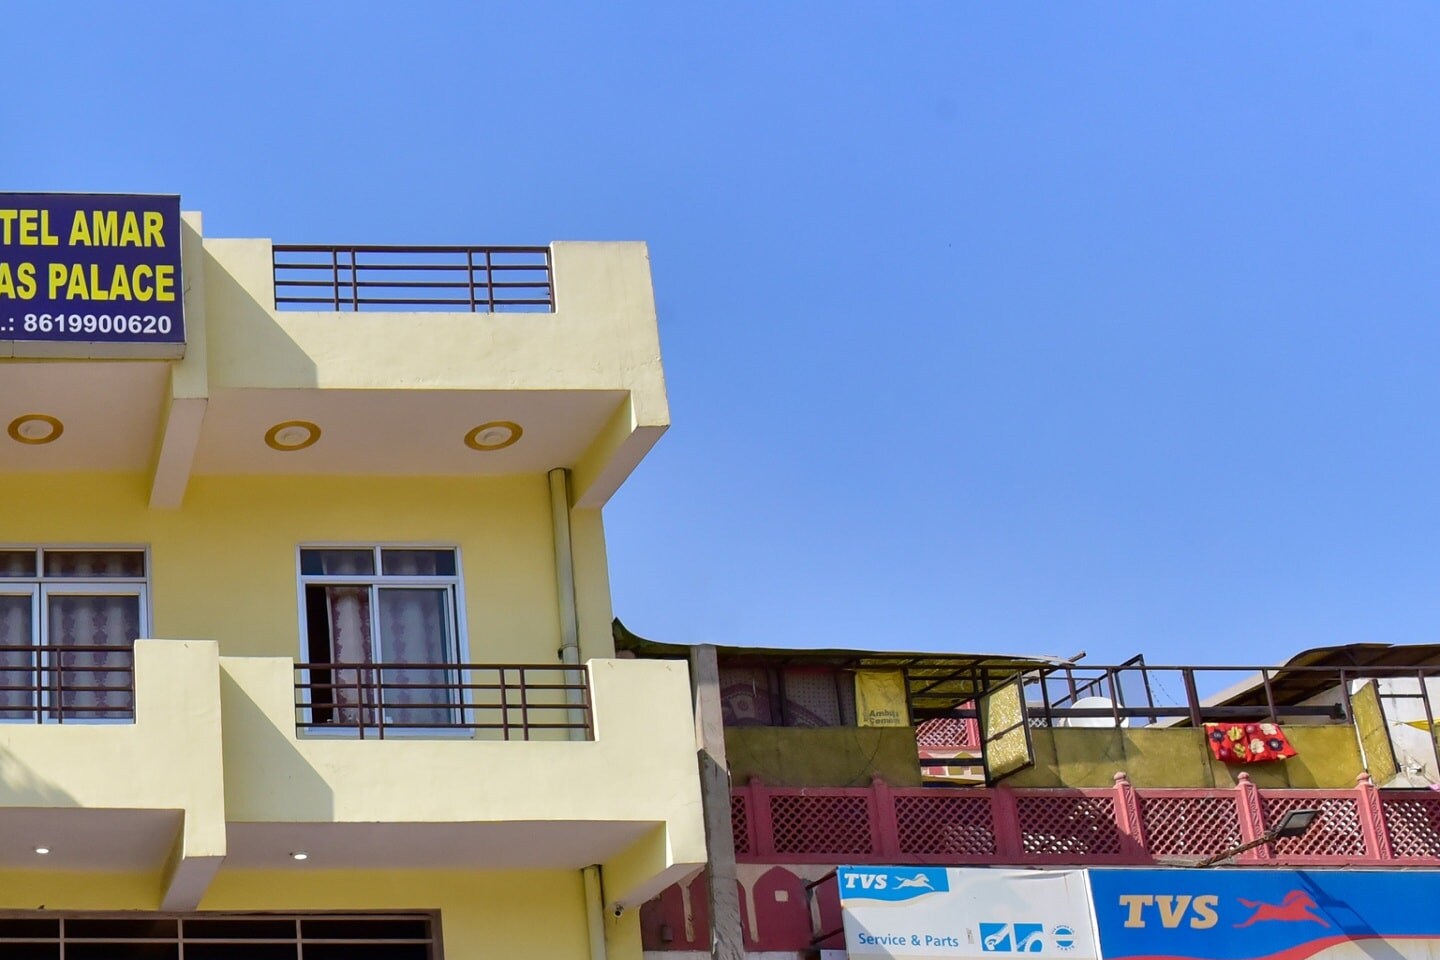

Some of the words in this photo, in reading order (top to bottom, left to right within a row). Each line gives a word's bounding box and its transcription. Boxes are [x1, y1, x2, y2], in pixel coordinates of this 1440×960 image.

[68, 209, 166, 248] AMAR
[48, 263, 176, 302] PALACE
[23, 313, 172, 335] 8619900620
[844, 873, 888, 890] TVS
[1118, 893, 1220, 931] TVS
[858, 933, 907, 946] Service
[911, 934, 921, 946] &
[925, 935, 959, 948] Parts
